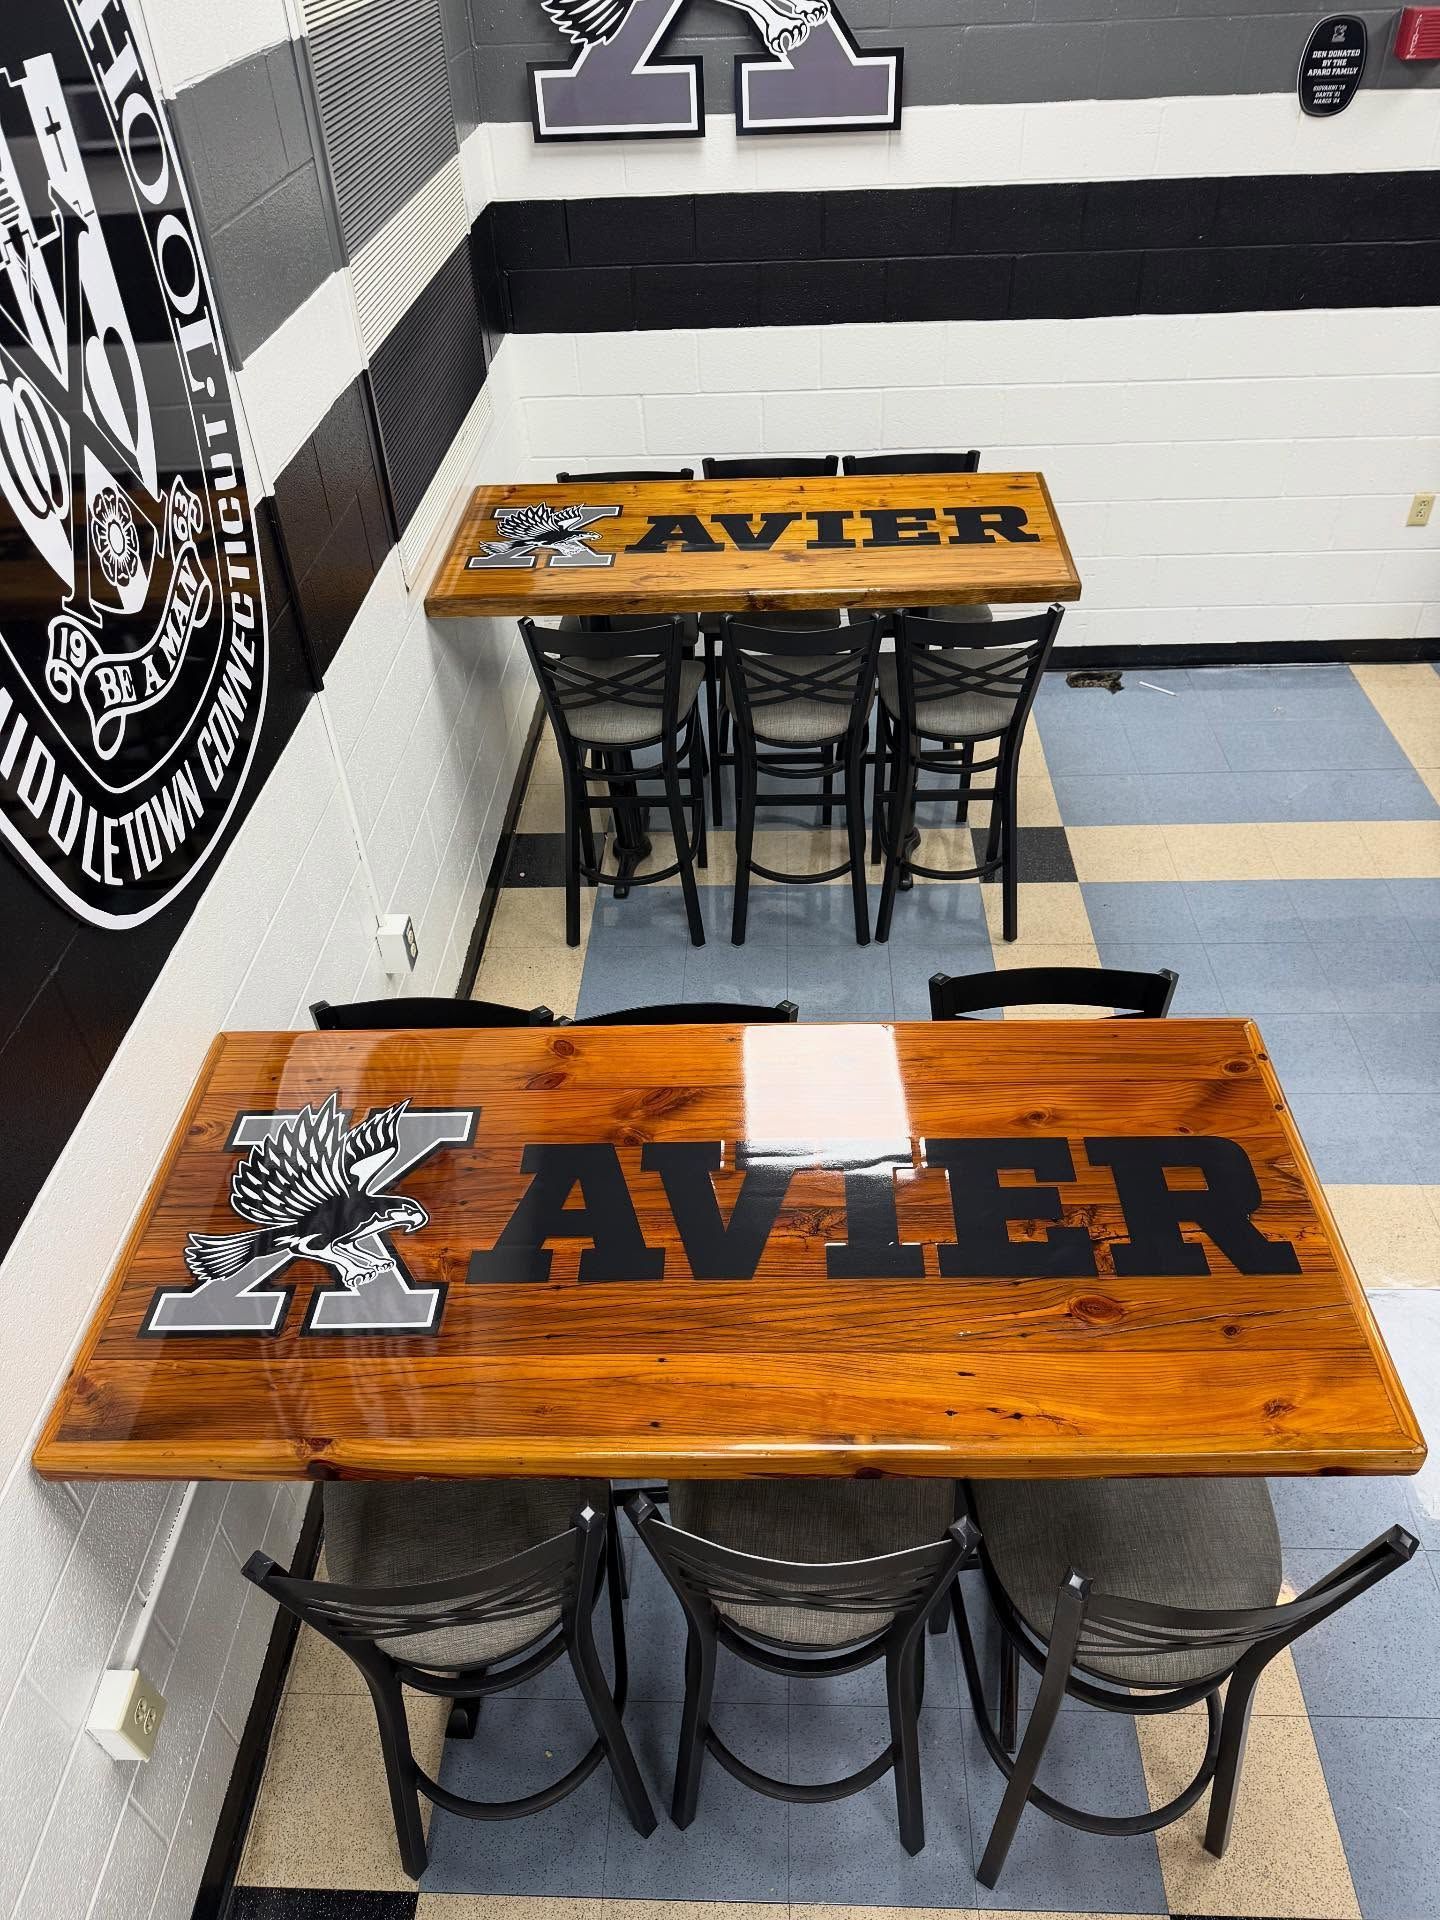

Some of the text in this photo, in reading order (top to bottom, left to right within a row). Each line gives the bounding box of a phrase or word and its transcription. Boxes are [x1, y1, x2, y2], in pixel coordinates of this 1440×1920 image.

[1328, 49, 1360, 57] DONATED
[1332, 67, 1358, 75] FAMILY
[0, 413, 255, 886] IDDLETOWN CONNECTICUT
[60, 627, 87, 668] 19
[95, 554, 199, 708] BE A MAN
